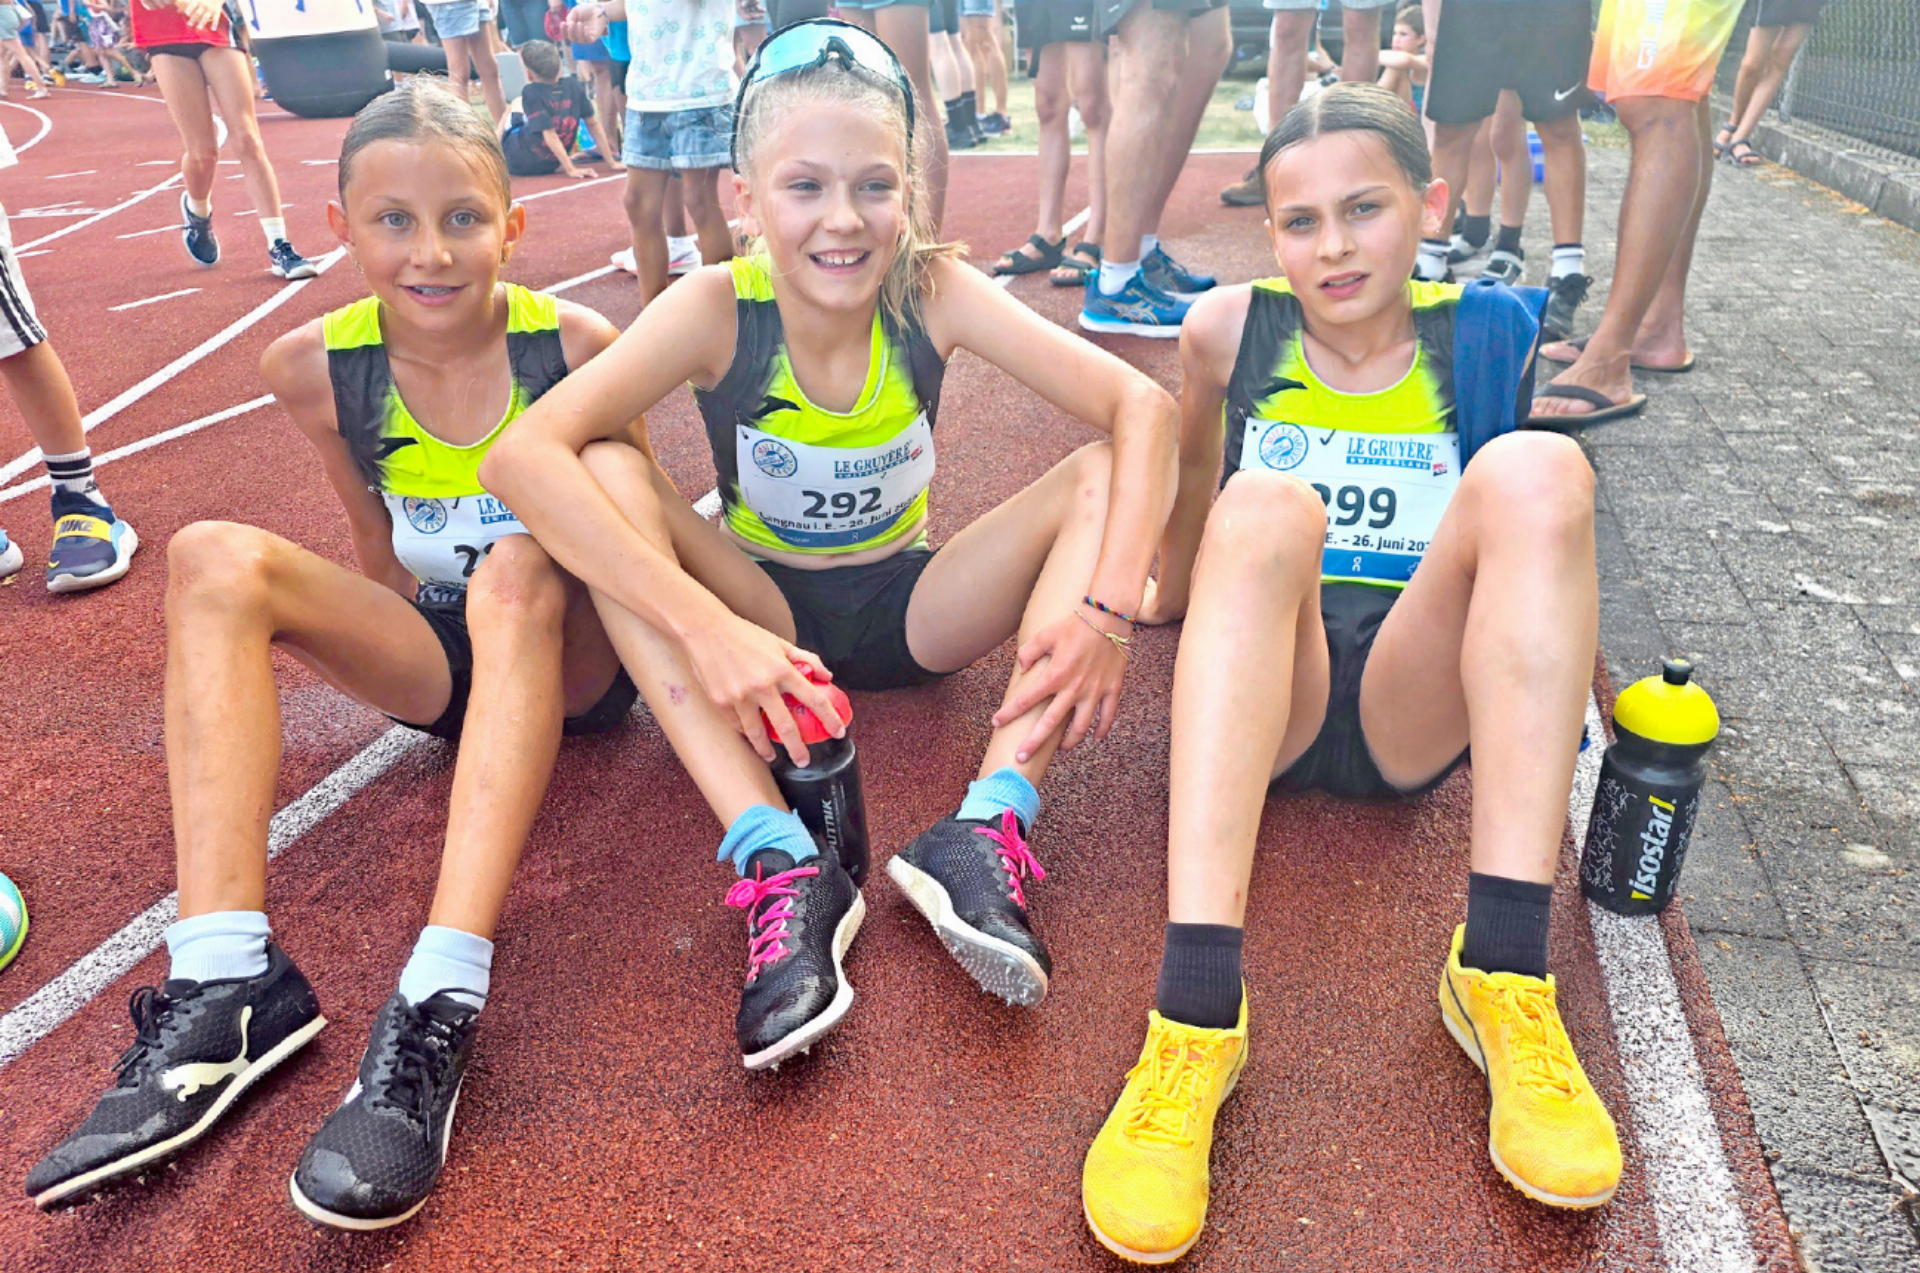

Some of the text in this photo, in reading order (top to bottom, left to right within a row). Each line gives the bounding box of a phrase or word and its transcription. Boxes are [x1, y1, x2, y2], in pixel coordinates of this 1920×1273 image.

[834, 461, 850, 472] LE
[853, 442, 911, 472] GRUYÈRE
[1347, 437, 1434, 460] LE GRUYÈRE
[476, 498, 496, 515] LE
[802, 486, 882, 519] 292
[58, 519, 95, 535] NIKE
[759, 511, 810, 529] Langnau
[870, 507, 892, 525] Juni
[1352, 534, 1374, 548] 26.
[1376, 536, 1405, 551] Juni
[1407, 540, 1430, 552] 20
[821, 799, 840, 863] PUTNIK
[1628, 800, 1674, 897] isostar
